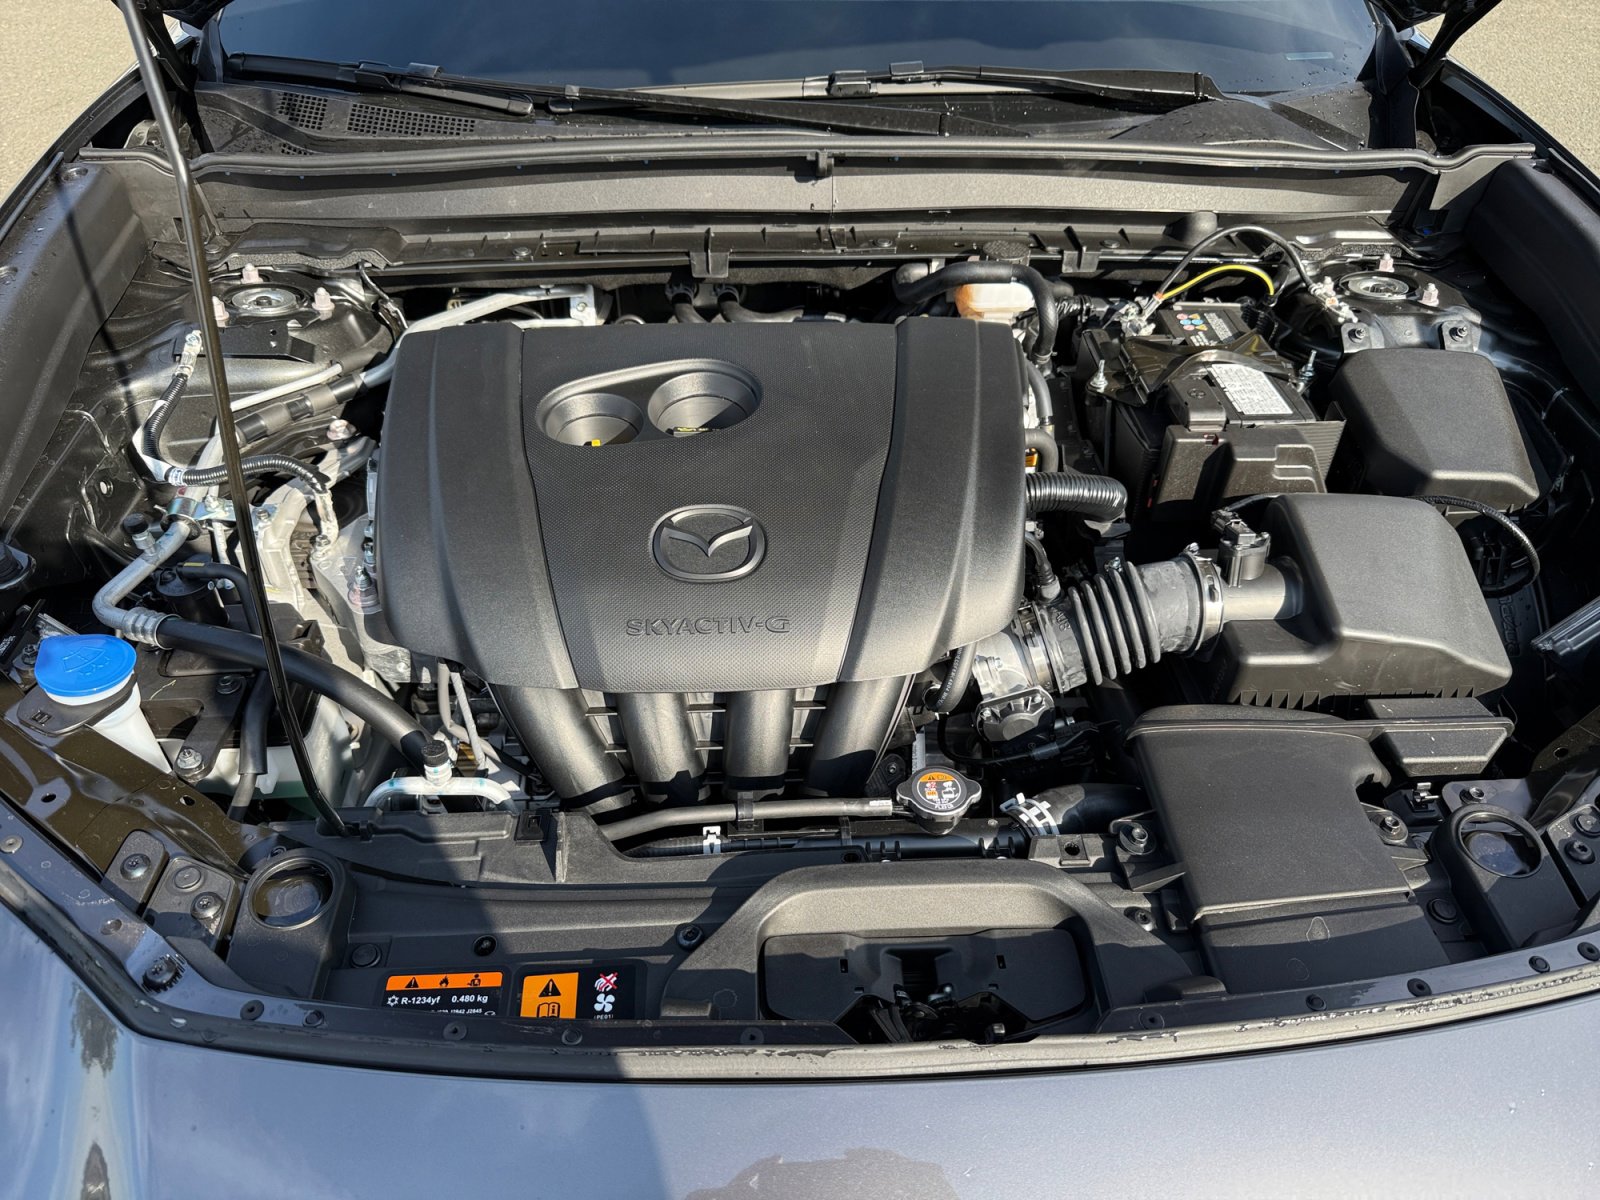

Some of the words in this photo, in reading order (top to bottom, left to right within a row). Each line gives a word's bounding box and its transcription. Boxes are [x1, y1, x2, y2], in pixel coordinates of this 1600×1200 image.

[626, 616, 790, 636] SKYACTIV-G
[401, 996, 440, 1005] R-1234yf
[451, 995, 475, 1003] 0.480
[477, 995, 488, 1003] kg
